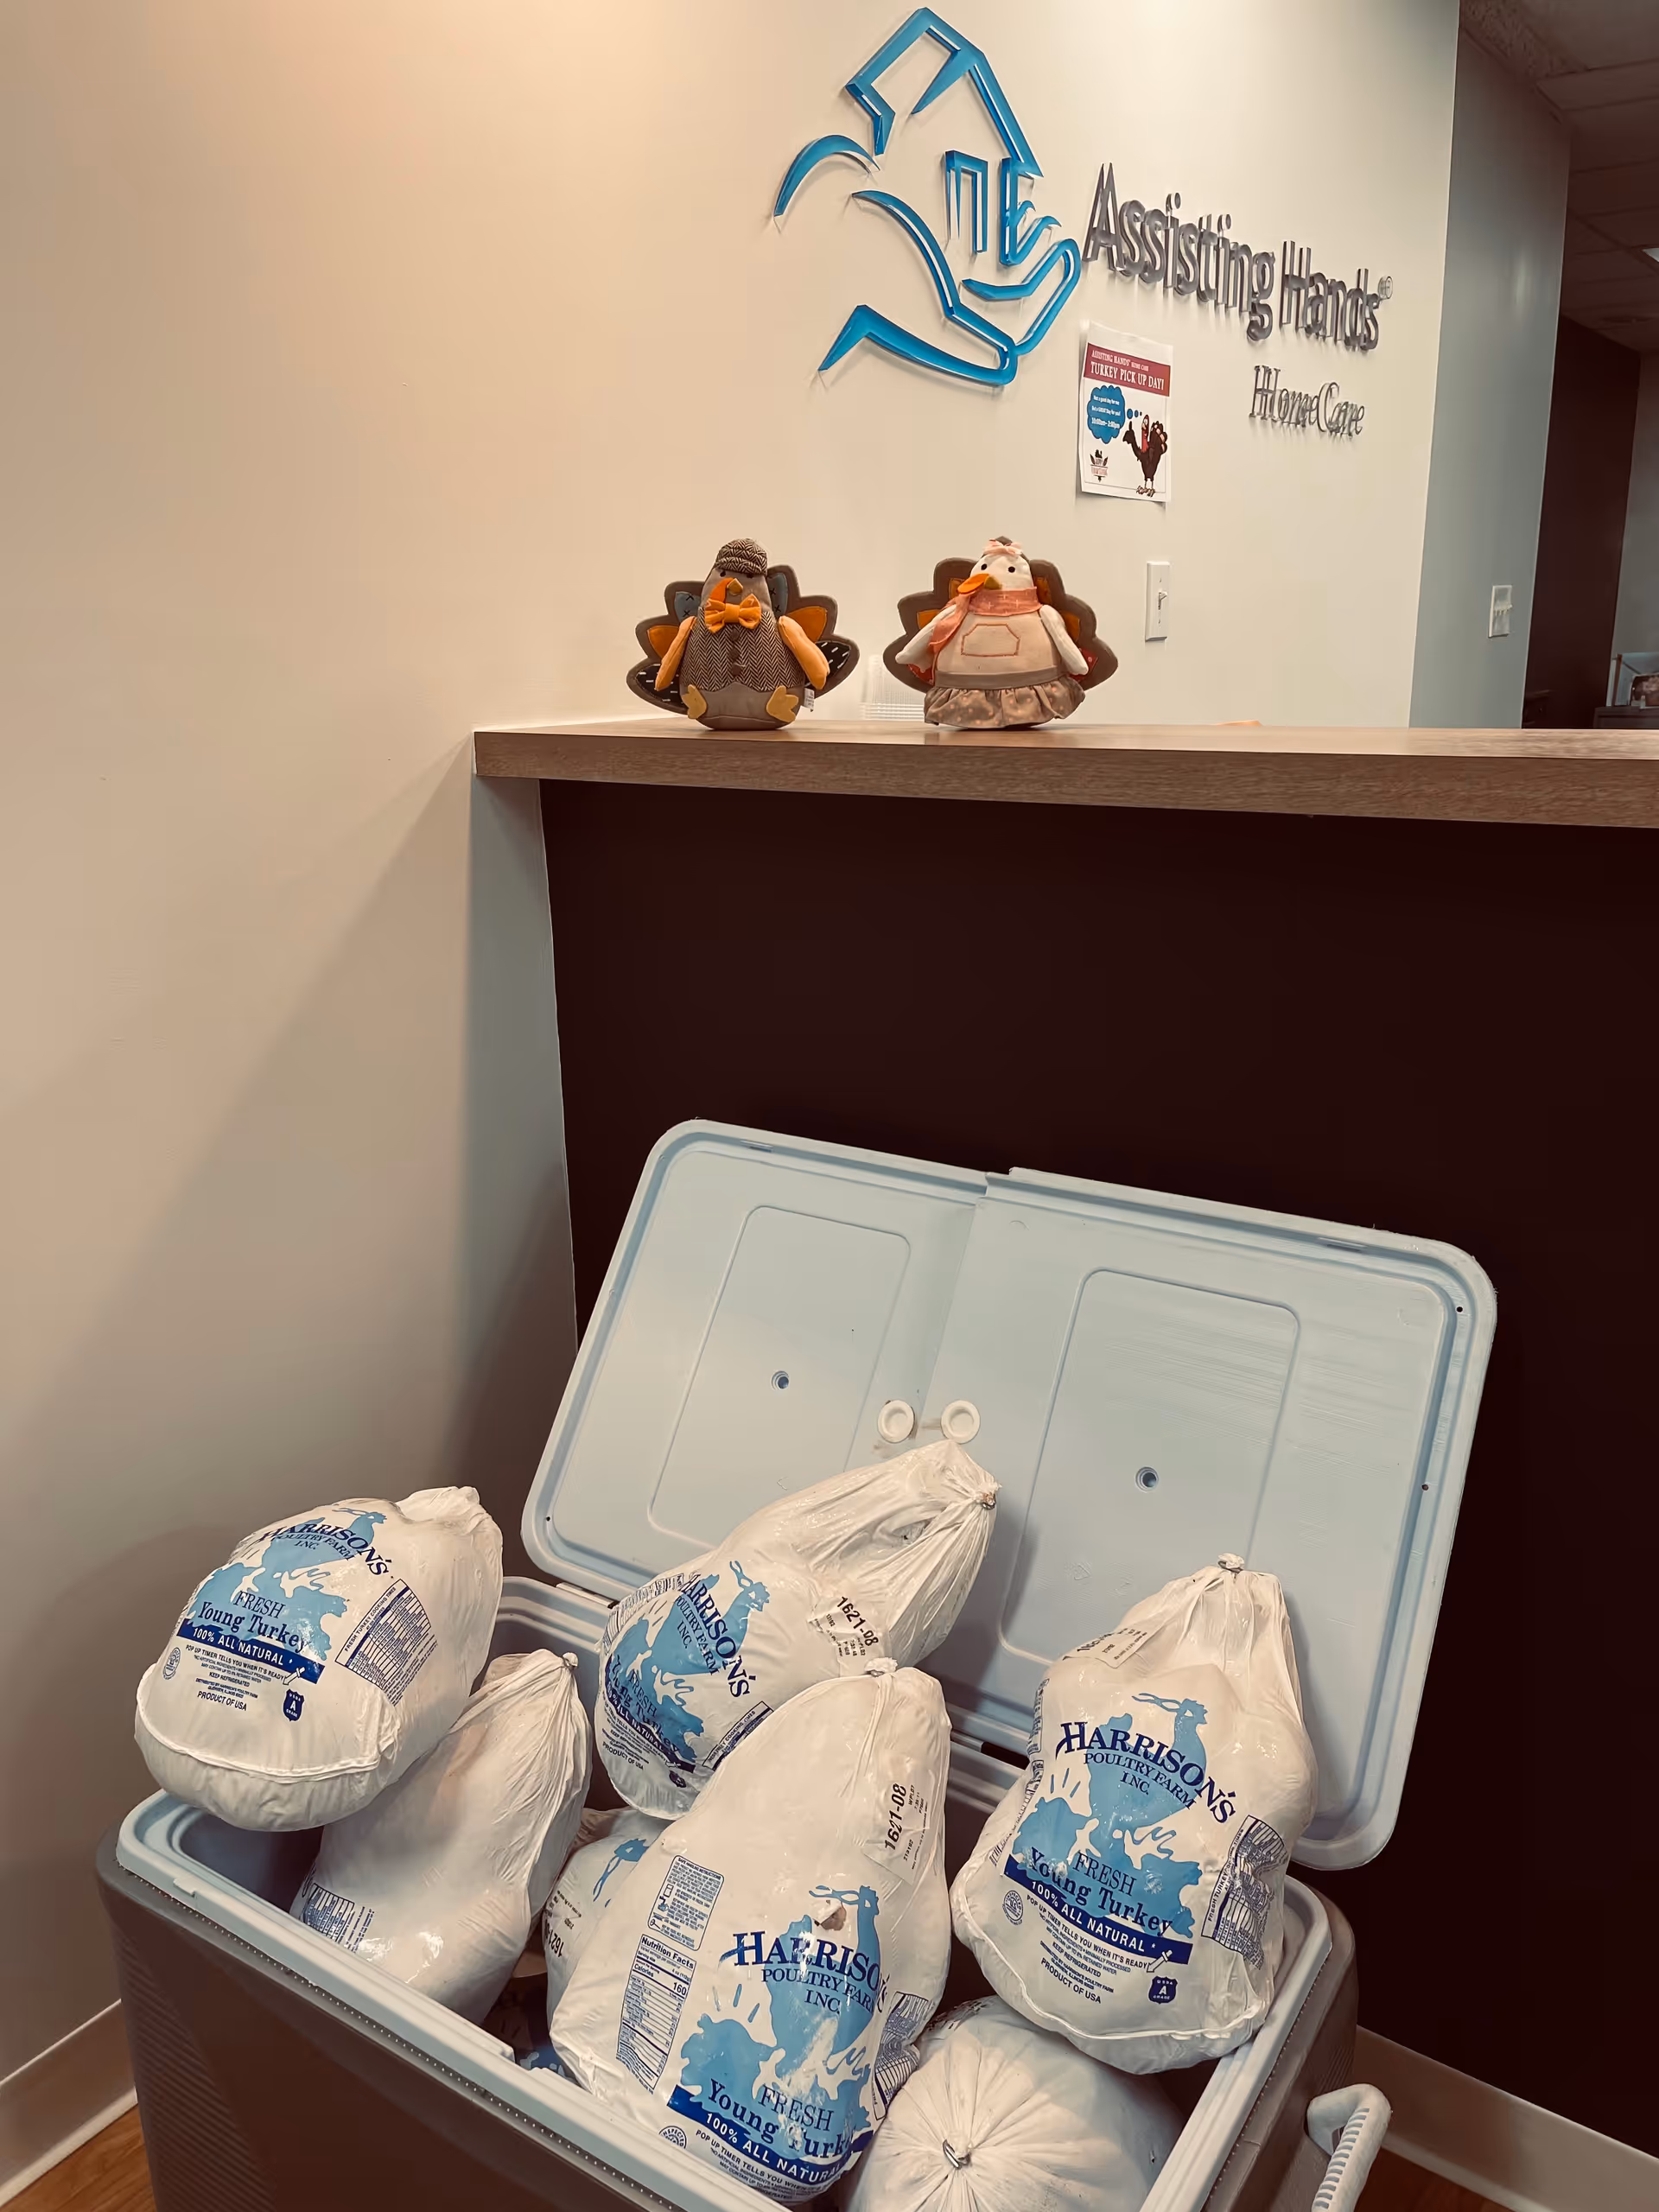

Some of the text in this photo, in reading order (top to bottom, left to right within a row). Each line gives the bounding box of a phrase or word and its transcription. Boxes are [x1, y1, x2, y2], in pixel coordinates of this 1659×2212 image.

[1083, 162, 1380, 350] Assisting Hands
[1091, 350, 1113, 363] ASSISTING
[1090, 361, 1165, 391] TURKEY PICK UP DAY!
[1249, 365, 1364, 437] Home Care
[294, 1541, 320, 1550] INC.
[325, 1538, 356, 1560] FARM
[233, 1591, 286, 1619] FRESH
[344, 1586, 396, 1652] FRESH TURKEY COOKING TIMES
[837, 1597, 879, 1646] 1621-08
[198, 1601, 311, 1653] Young Turkey
[677, 1620, 692, 1649] INC.
[194, 1628, 283, 1666] 100% ALL NATURAL
[696, 1632, 719, 1675] FARM
[202, 1649, 218, 1659] TIMER
[218, 1654, 232, 1664] TELLS
[232, 1658, 243, 1668] YOU
[243, 1662, 257, 1671] WHEN
[258, 1666, 268, 1675] IT'S
[268, 1669, 284, 1681] READY
[209, 1671, 219, 1680] KEEP
[221, 1675, 251, 1687] REFRIGERATED
[197, 1690, 226, 1703] PRODUCT
[226, 1698, 234, 1707] OF
[235, 1700, 247, 1711] USA
[289, 1693, 301, 1701] USDA
[290, 1700, 296, 1711] A
[629, 1669, 657, 1717] FRESH
[286, 1708, 297, 1718] GRADE
[617, 1705, 630, 1721] ALL
[632, 1718, 664, 1752] NATURAL
[726, 1723, 743, 1742] COOKING
[603, 1741, 627, 1759] PRODUCT
[635, 1761, 644, 1770] USA
[1055, 1721, 1236, 1823] HARRISON'S
[1084, 1752, 1196, 1809] POULTRY FARM
[1120, 1771, 1149, 1796] INC.
[885, 1783, 907, 1850] 1621-08
[1031, 1847, 1173, 1936] Young Turkey
[1073, 1853, 1137, 1896] FRESH
[1215, 1872, 1229, 1904] TURKEY
[1027, 1894, 1147, 1969] POP UP TIMER TELLS YOU WHEN IT'S READY
[1031, 1880, 1058, 1908] 100%
[1061, 1904, 1083, 1925] ALL
[1087, 1918, 1146, 1953] NATURAL
[641, 1937, 672, 1959] Nutrition
[672, 1951, 695, 1968] Facts
[1052, 1942, 1101, 1977] KEEP REFRIGERATED
[634, 1963, 654, 1977] Calories
[672, 1982, 687, 1996] 160
[761, 1968, 843, 1994] POULTRY
[1040, 1958, 1071, 1987] PRODUCT
[1073, 1983, 1084, 1994] OF
[1085, 1989, 1101, 2003] USA
[1160, 1986, 1166, 1995] A
[804, 1989, 842, 2014] INC.
[709, 2079, 779, 2145] Young
[759, 2084, 835, 2132] FRESH
[696, 2129, 710, 2141] POP
[710, 2138, 721, 2149] UP
[721, 2144, 741, 2164] TIMER
[743, 2160, 766, 2177] TELLS
[766, 2171, 783, 2184] YOU
[785, 2179, 806, 2190] WHEN
[706, 2113, 840, 2183] 100% ALL NATURAL
